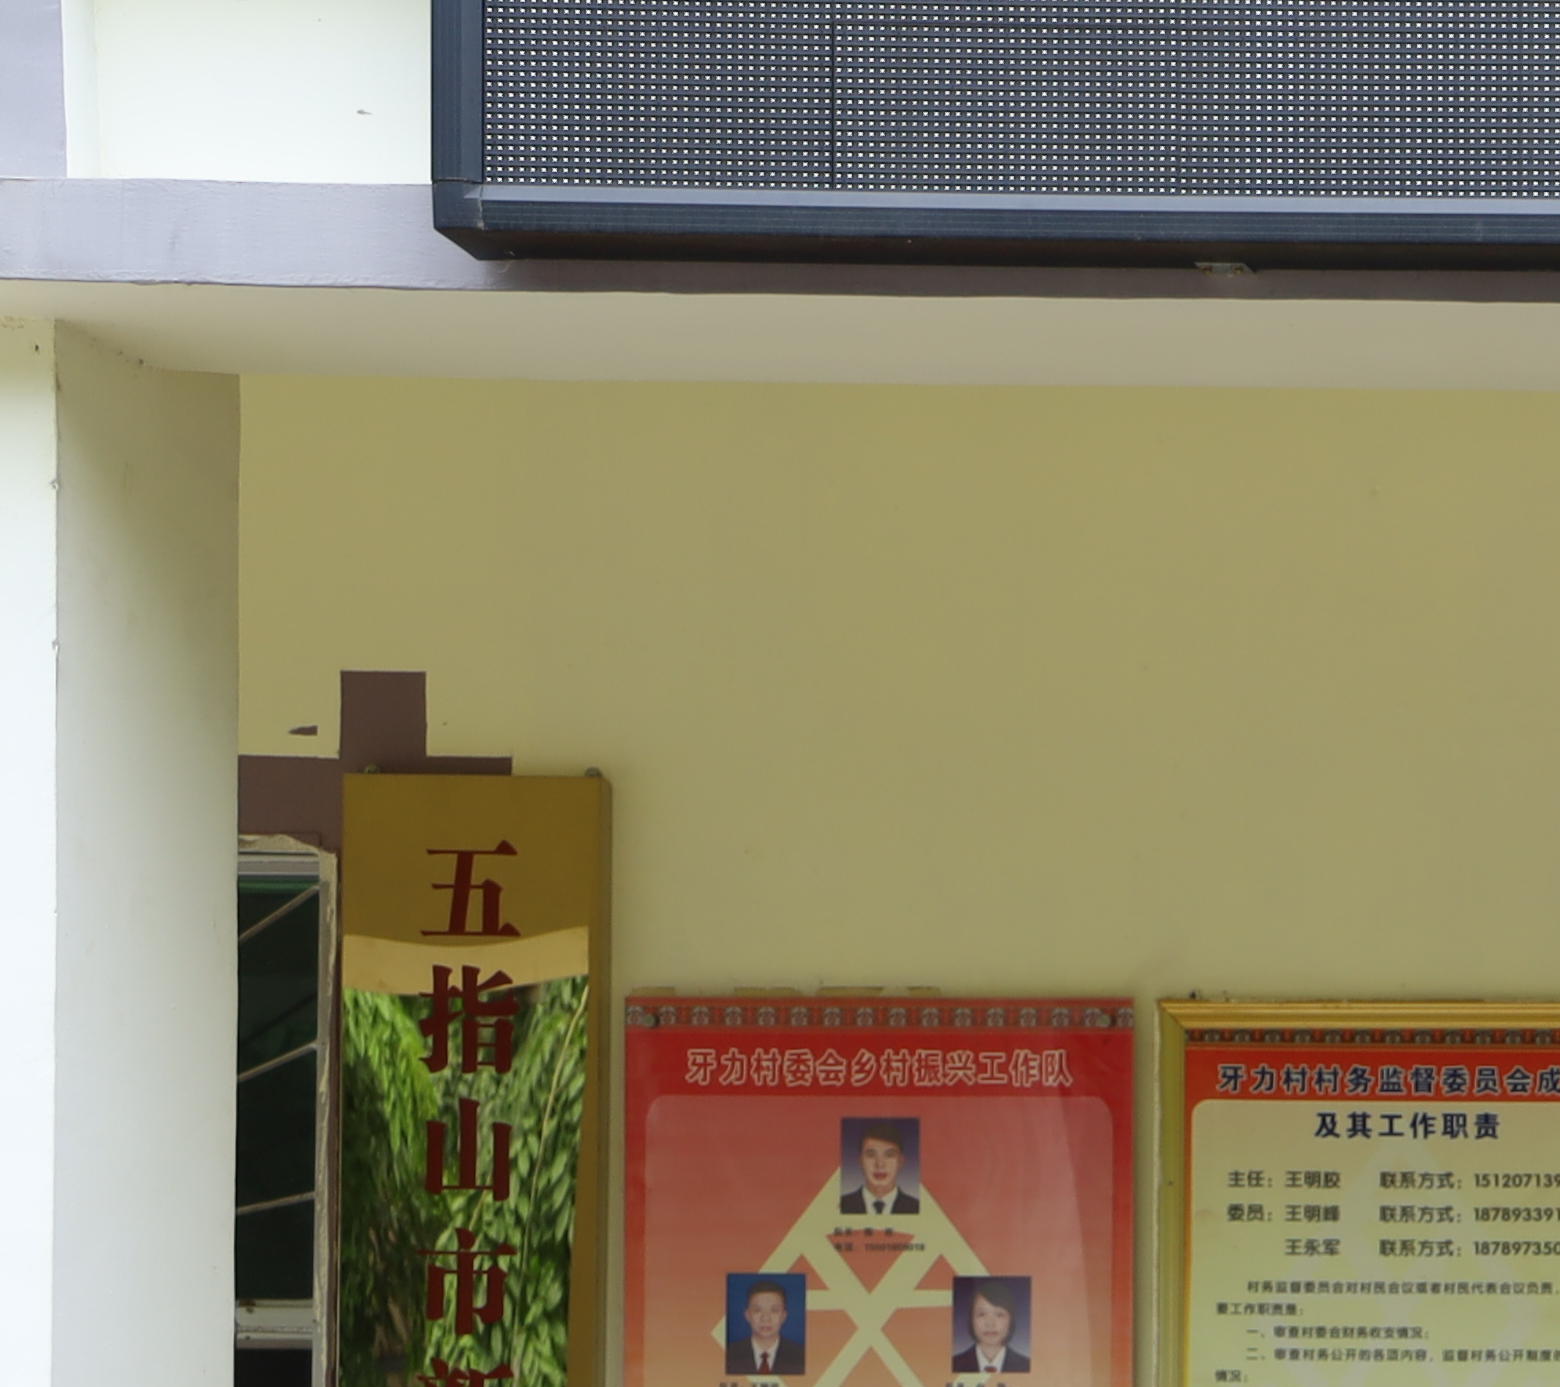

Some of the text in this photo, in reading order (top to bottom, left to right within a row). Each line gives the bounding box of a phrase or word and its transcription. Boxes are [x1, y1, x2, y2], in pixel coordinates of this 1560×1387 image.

[685, 1049, 1073, 1087] 牙力村委会乡村振兴工作队
[1315, 1113, 1501, 1139] 及其工作职责
[1285, 1238, 1340, 1257] 王永军
